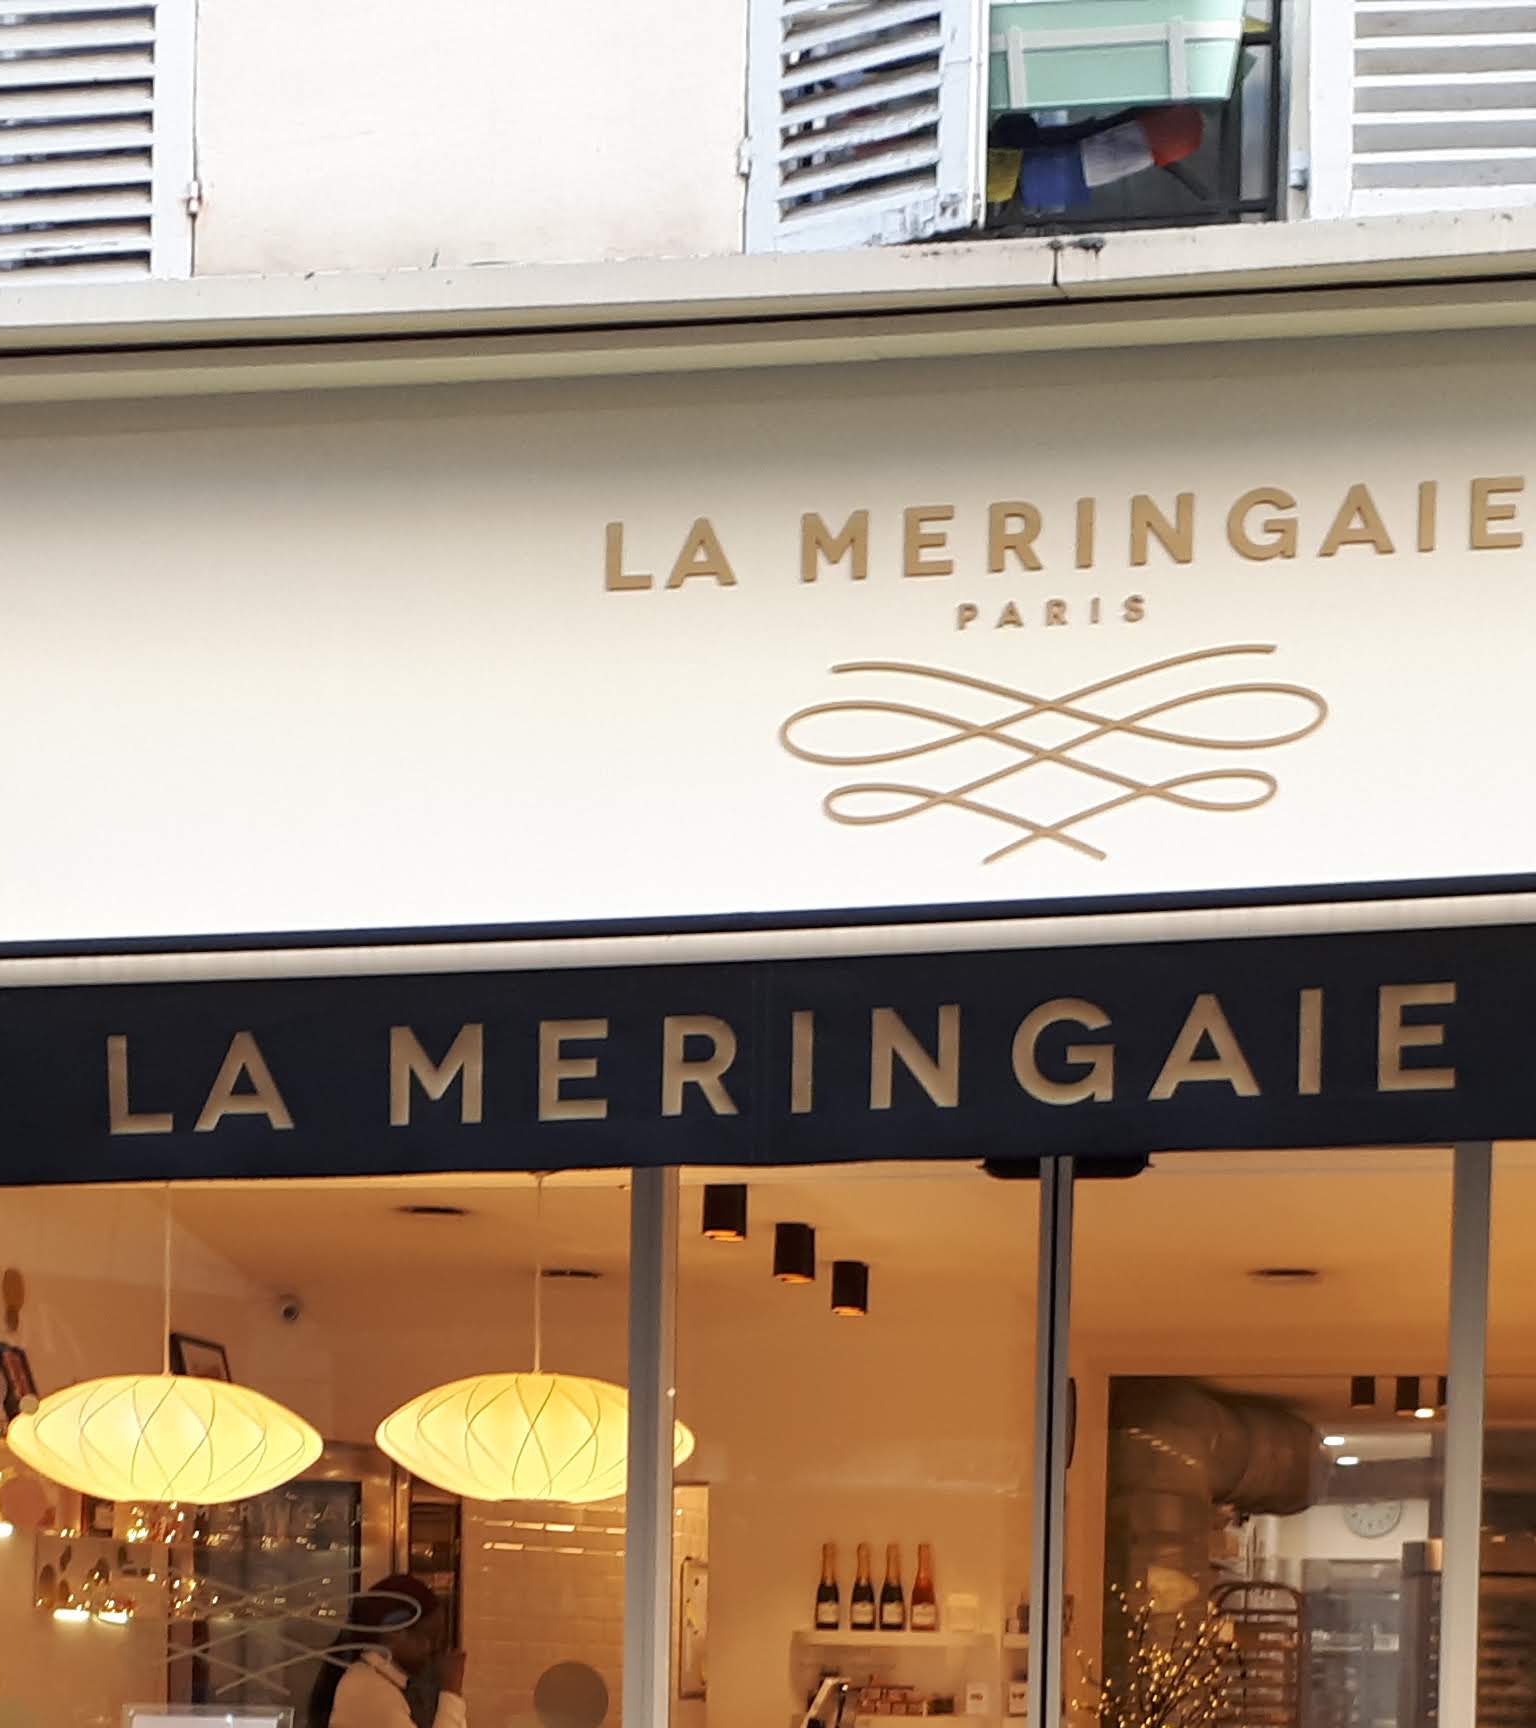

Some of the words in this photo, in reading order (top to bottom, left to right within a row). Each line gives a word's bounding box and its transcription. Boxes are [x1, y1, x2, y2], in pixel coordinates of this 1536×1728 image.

[604, 518, 737, 592] LA
[800, 476, 1526, 583] MERINGAIE
[957, 594, 1148, 631] PARIS
[107, 1031, 295, 1136] LA
[390, 982, 1457, 1126] MERINGAIE
